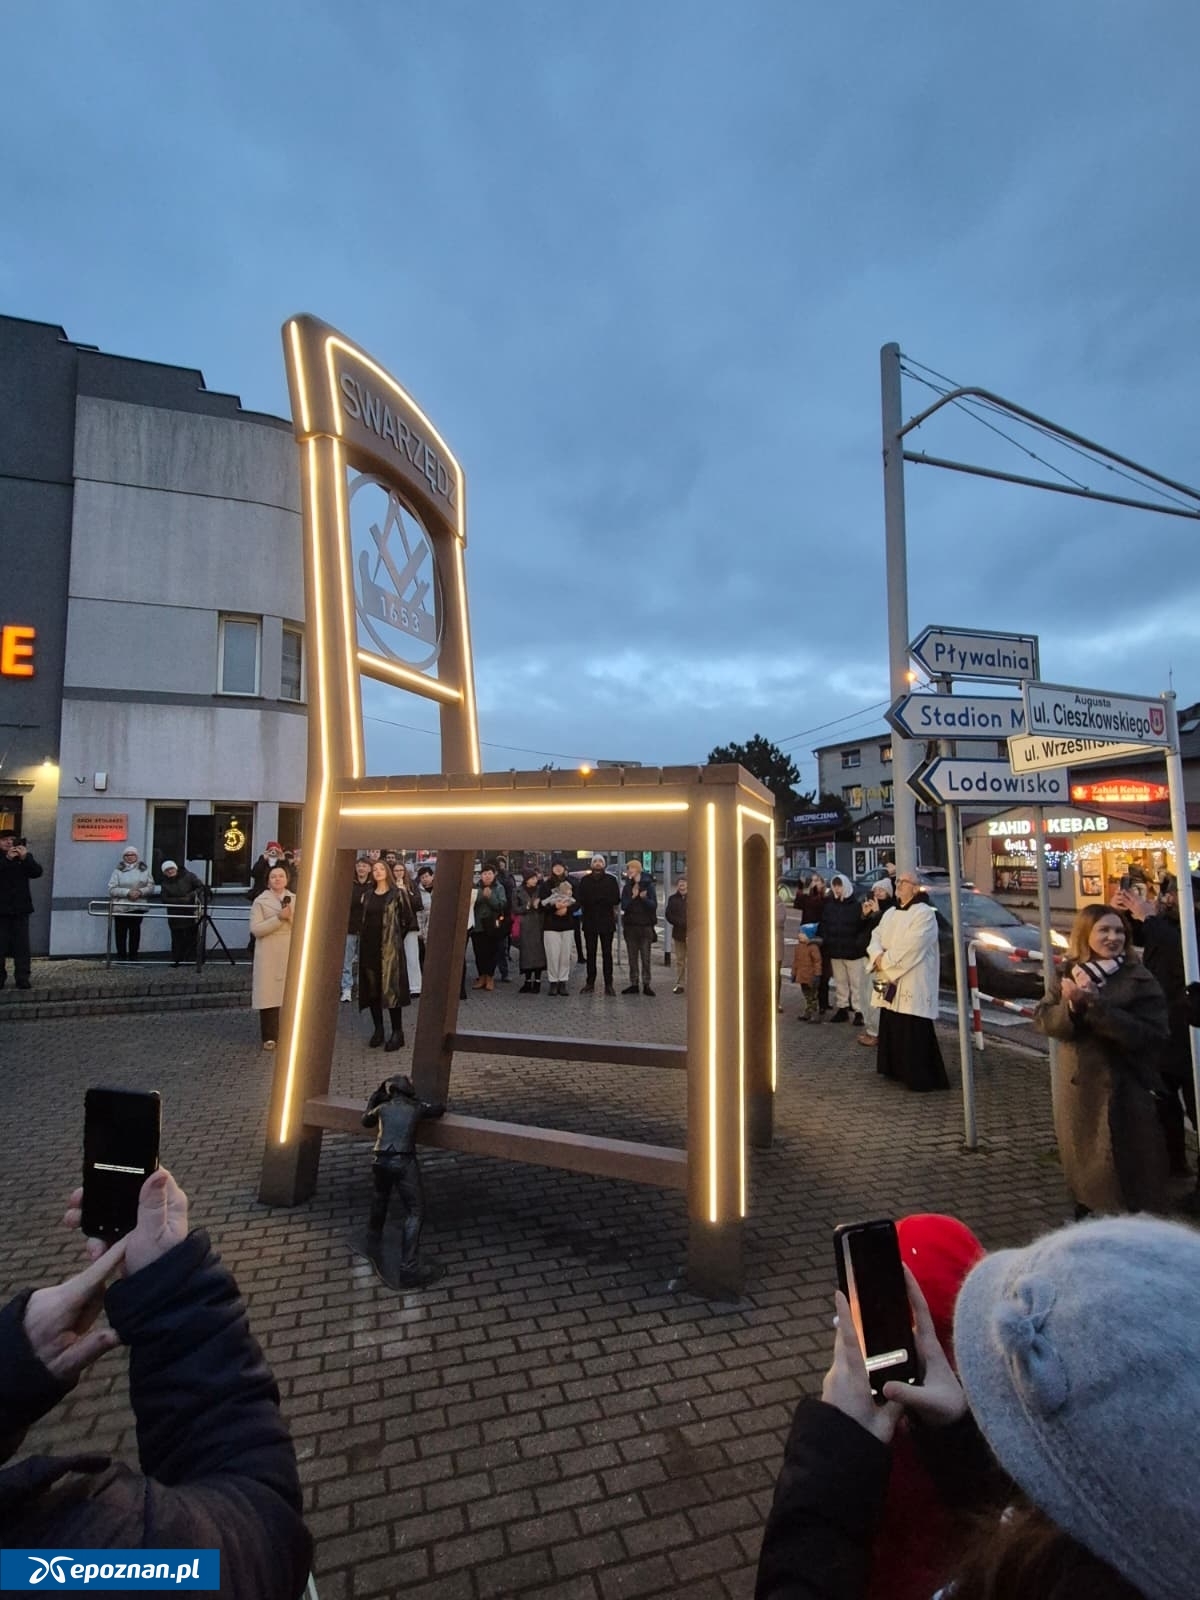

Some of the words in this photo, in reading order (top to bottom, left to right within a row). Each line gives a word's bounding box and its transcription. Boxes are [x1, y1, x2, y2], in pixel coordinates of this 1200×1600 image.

[340, 373, 457, 506] SWARZĘDZ
[380, 596, 419, 632] 1653
[1, 623, 36, 676] E
[934, 642, 1029, 671] Pływalnia
[1074, 695, 1112, 709] Augusta
[921, 705, 1002, 728] Stadion
[1034, 702, 1050, 724] ul.
[1053, 703, 1150, 738] Cieszkowskiego
[1024, 744, 1040, 762] ul.
[948, 771, 1060, 794] Lodowisko
[988, 820, 1031, 836] ZAHID
[1047, 817, 1108, 833] KEBAB
